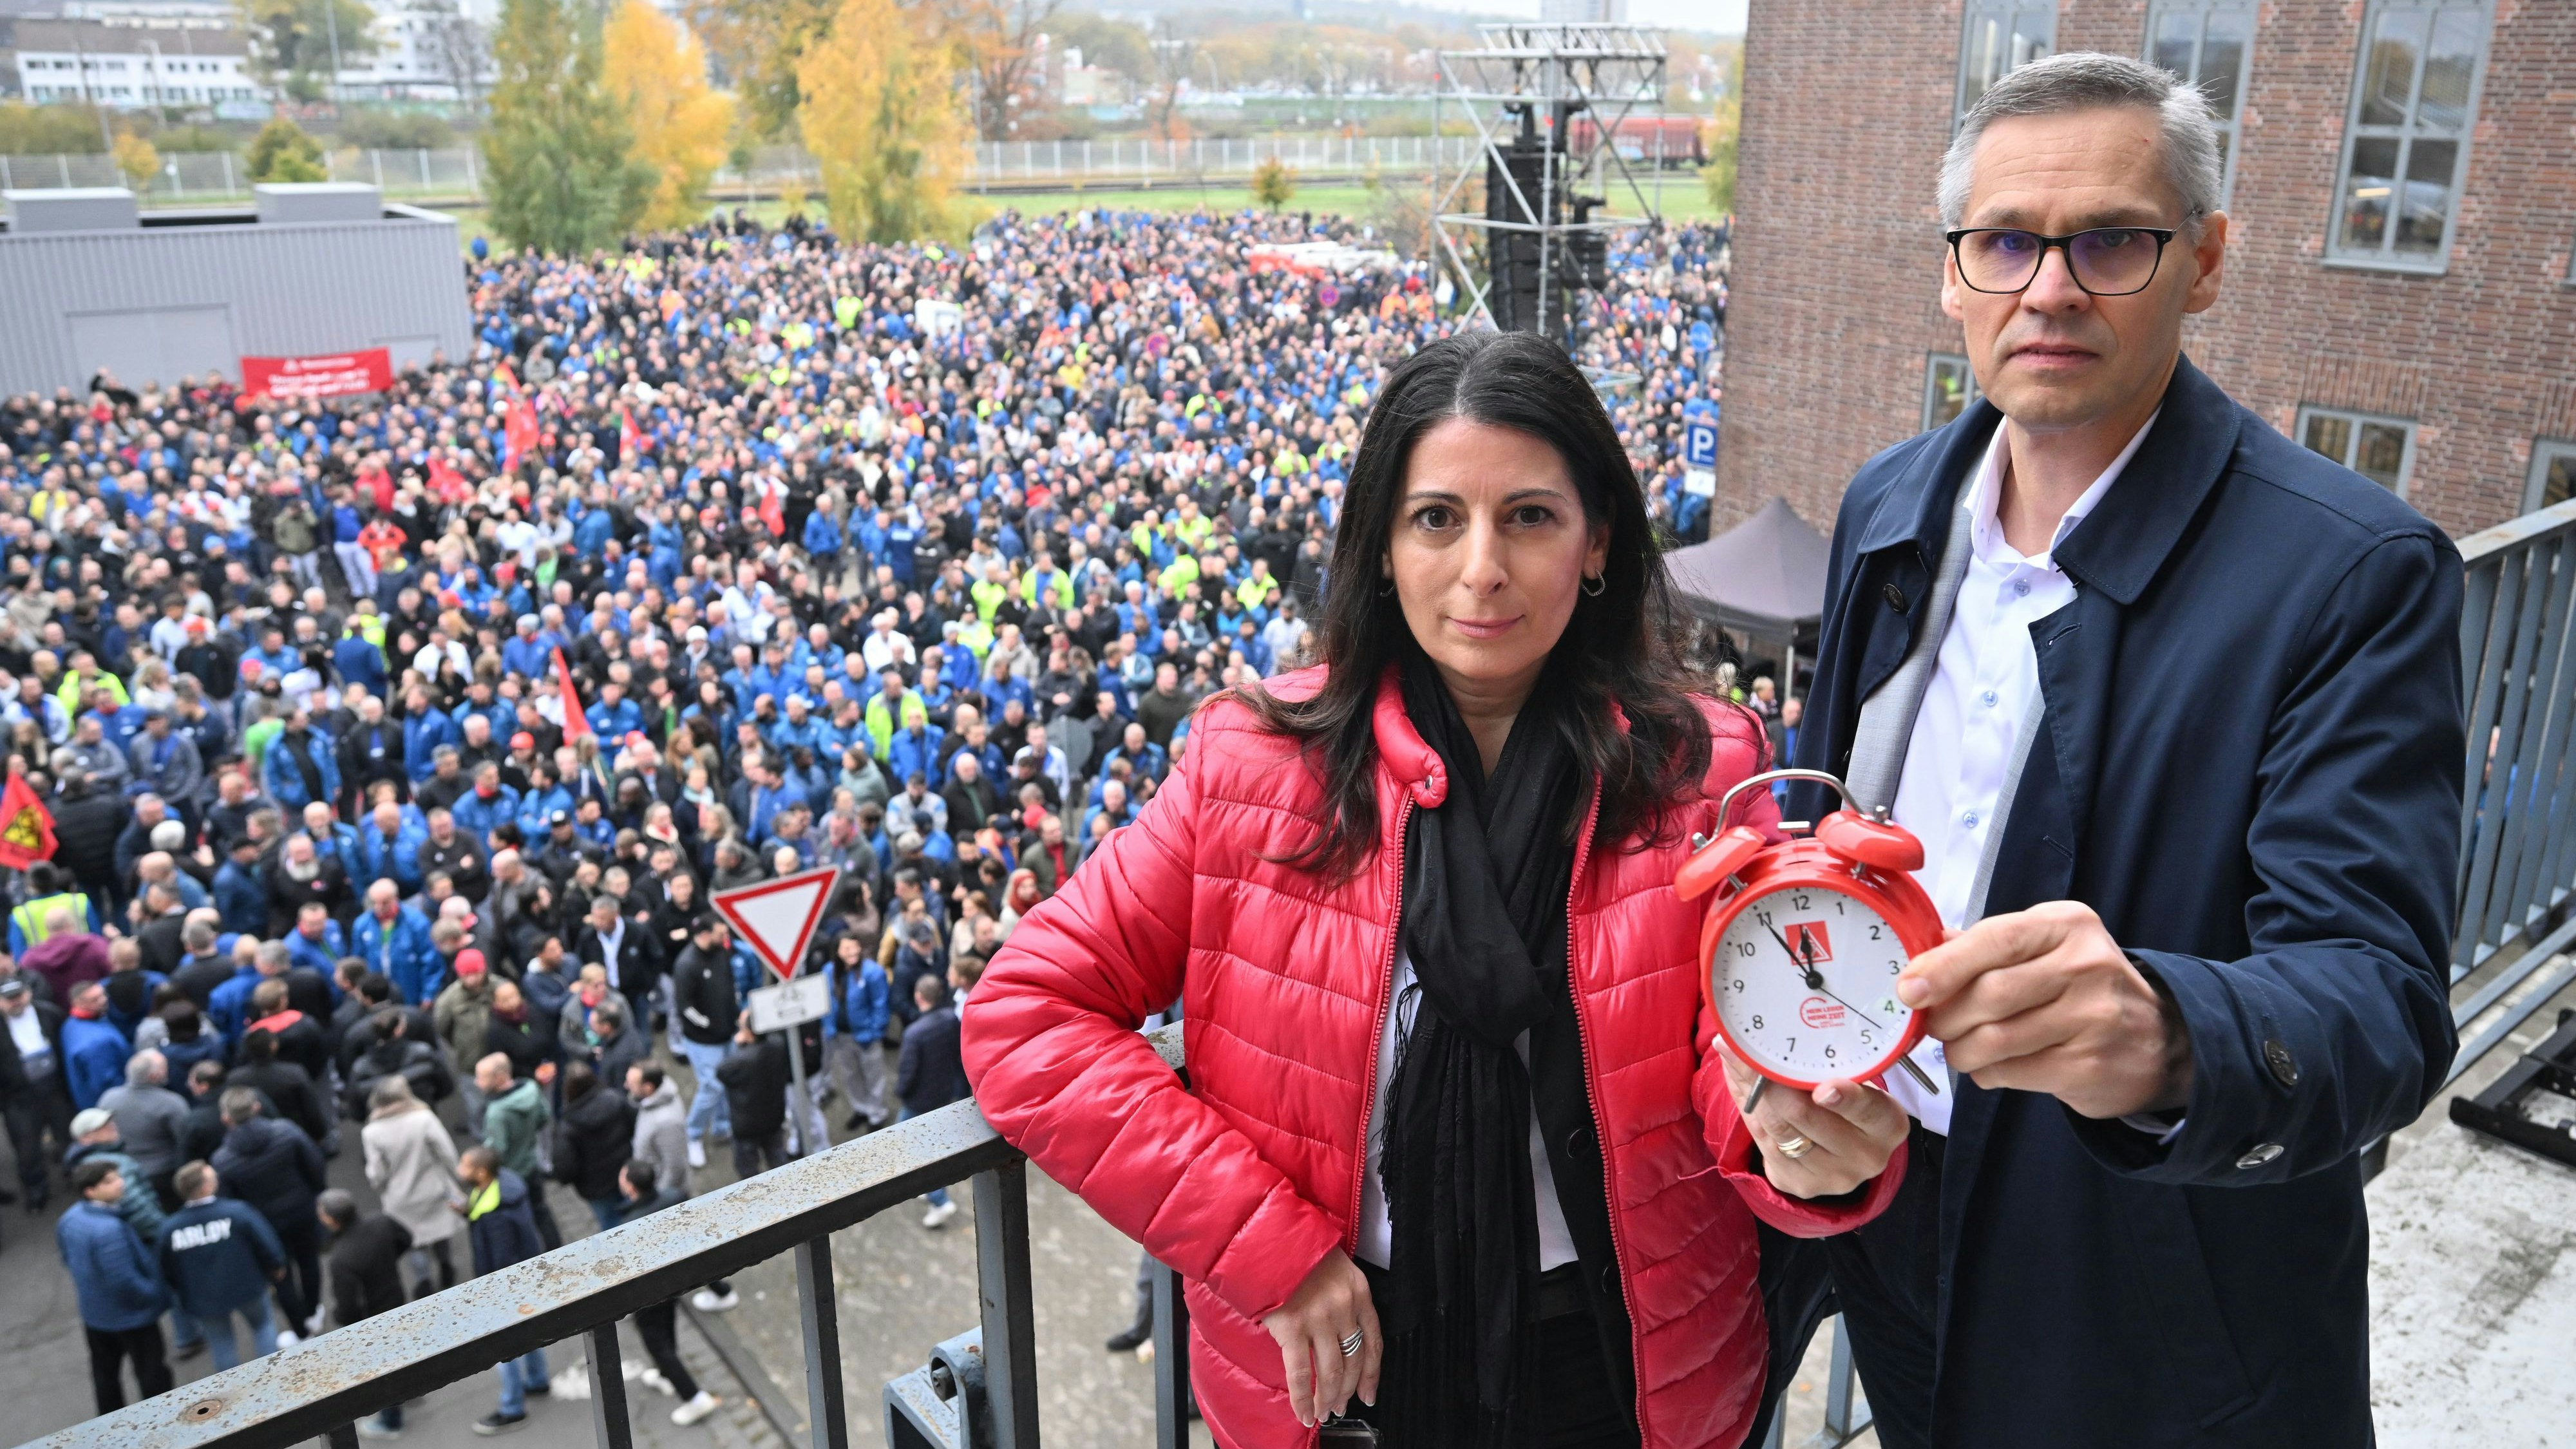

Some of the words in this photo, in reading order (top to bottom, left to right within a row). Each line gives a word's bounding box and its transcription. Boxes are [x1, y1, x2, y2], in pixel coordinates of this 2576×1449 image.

[1692, 427, 1714, 460] P
[1792, 895, 1811, 911] 12
[1836, 902, 1844, 915] 1
[1756, 911, 1772, 926] 11
[1869, 925, 1881, 940] 2
[1737, 942, 1755, 958] 10
[1888, 960, 1900, 974] 3
[1734, 980, 1744, 993] 9
[1884, 1000, 1894, 1013] 4
[1752, 1015, 1763, 1029] 8
[1861, 1030, 1871, 1044] 5
[1786, 1037, 1795, 1052] 7
[1825, 1045, 1835, 1058] 6
